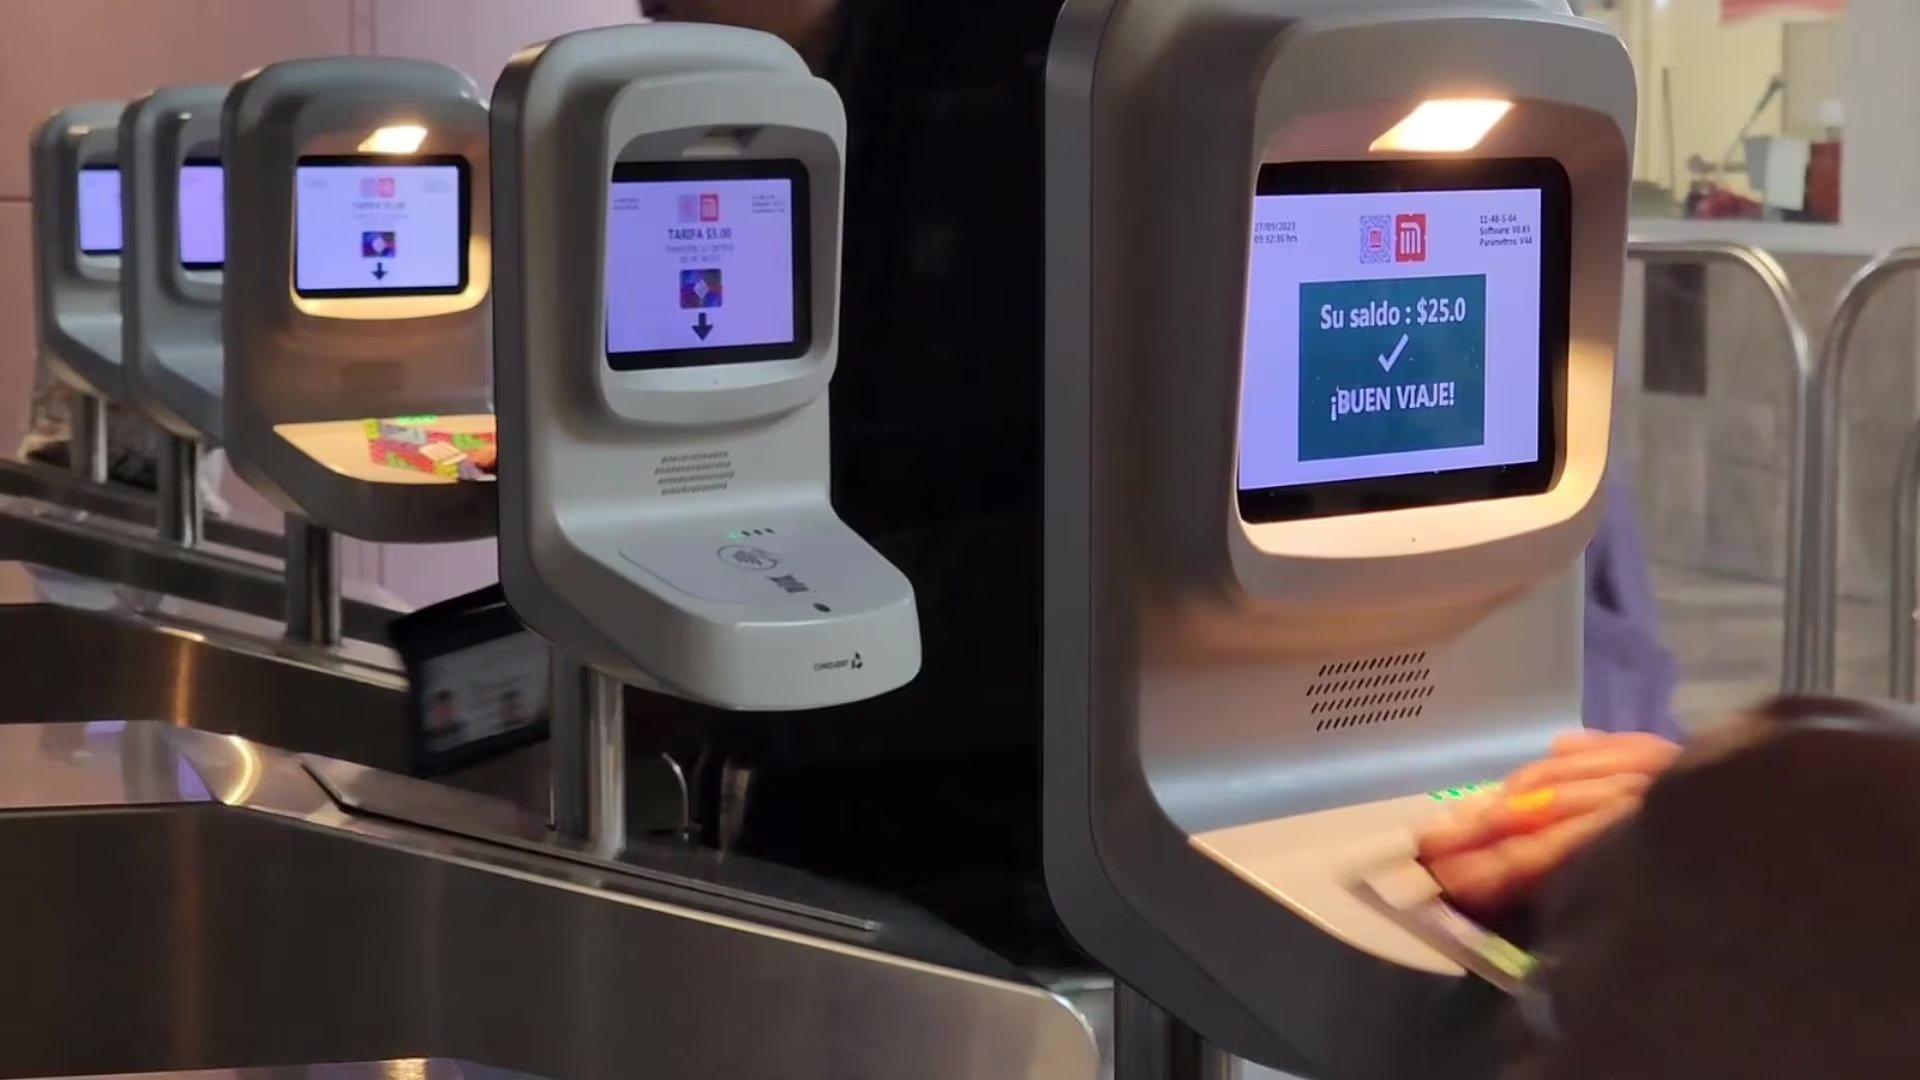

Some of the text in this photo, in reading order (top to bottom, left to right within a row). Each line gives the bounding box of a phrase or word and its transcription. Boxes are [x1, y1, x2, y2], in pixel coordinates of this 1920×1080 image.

[667, 228, 704, 241] TARIFA
[1320, 303, 1344, 330] Su
[1349, 300, 1400, 328] saldo
[1416, 296, 1466, 326] $25.0
[1330, 381, 1455, 421] ¡BUEN VIAJE!
